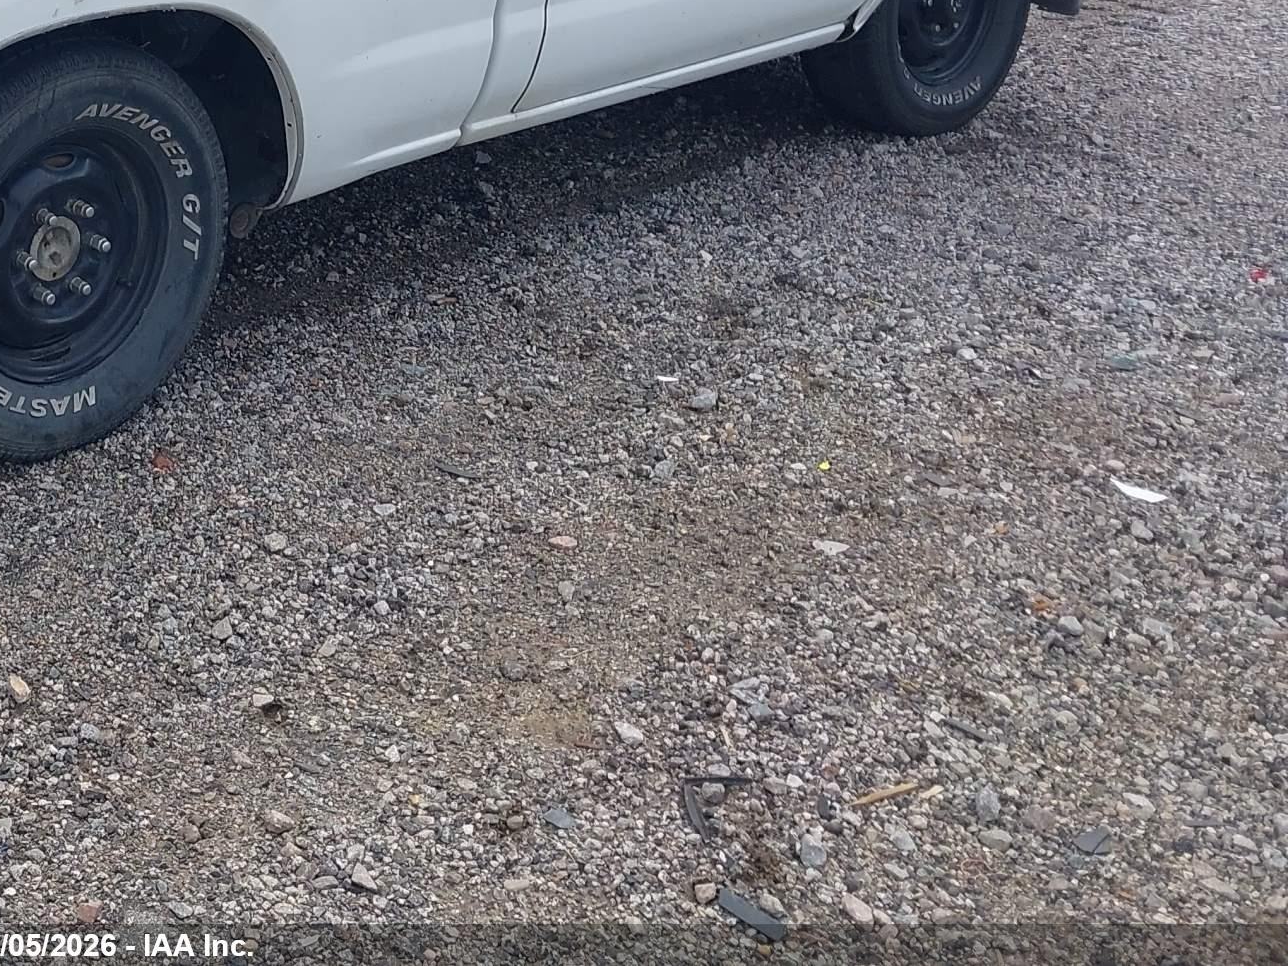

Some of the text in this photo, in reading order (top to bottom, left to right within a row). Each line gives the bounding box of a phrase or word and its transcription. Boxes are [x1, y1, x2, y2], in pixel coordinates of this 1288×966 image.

[913, 75, 982, 106] AVENGER
[75, 103, 202, 260] AVENGER G/T
